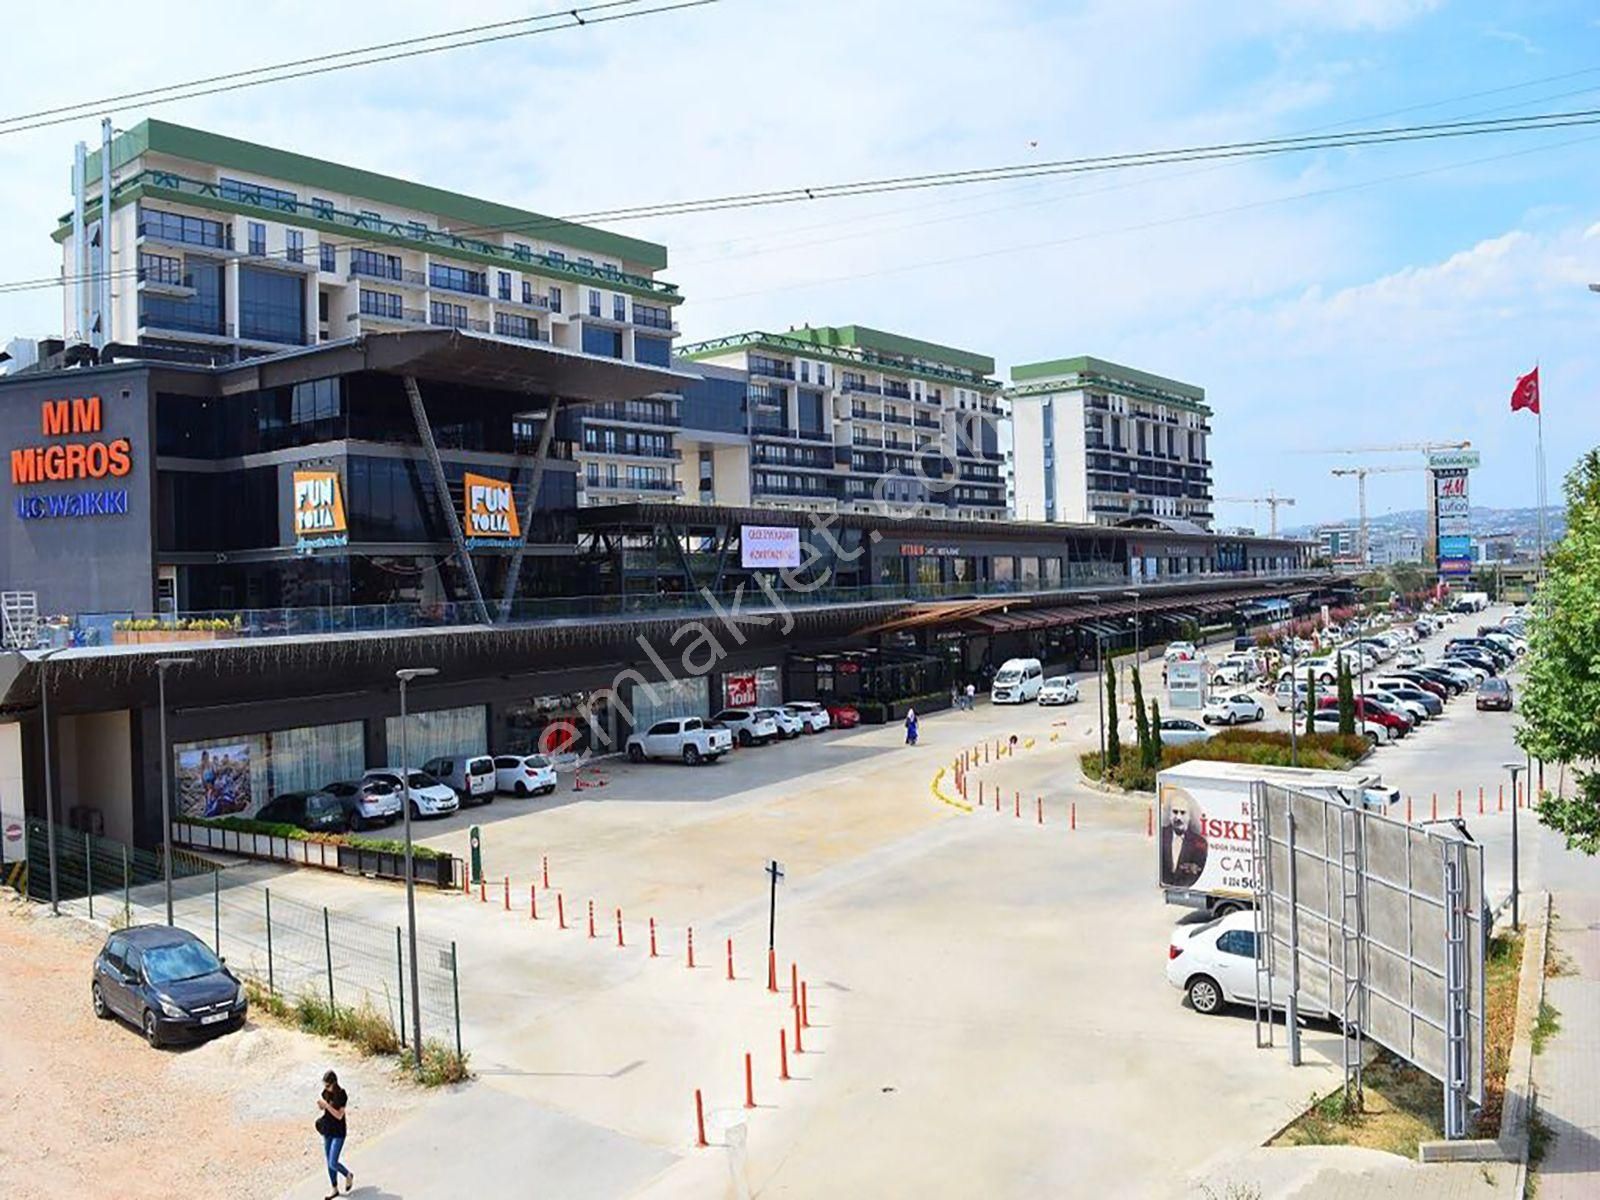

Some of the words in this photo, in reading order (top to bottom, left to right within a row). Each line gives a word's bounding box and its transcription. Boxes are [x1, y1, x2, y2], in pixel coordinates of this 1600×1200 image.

[42, 396, 101, 436] MM
[296, 478, 335, 510] FUN
[471, 485, 511, 513] FUN
